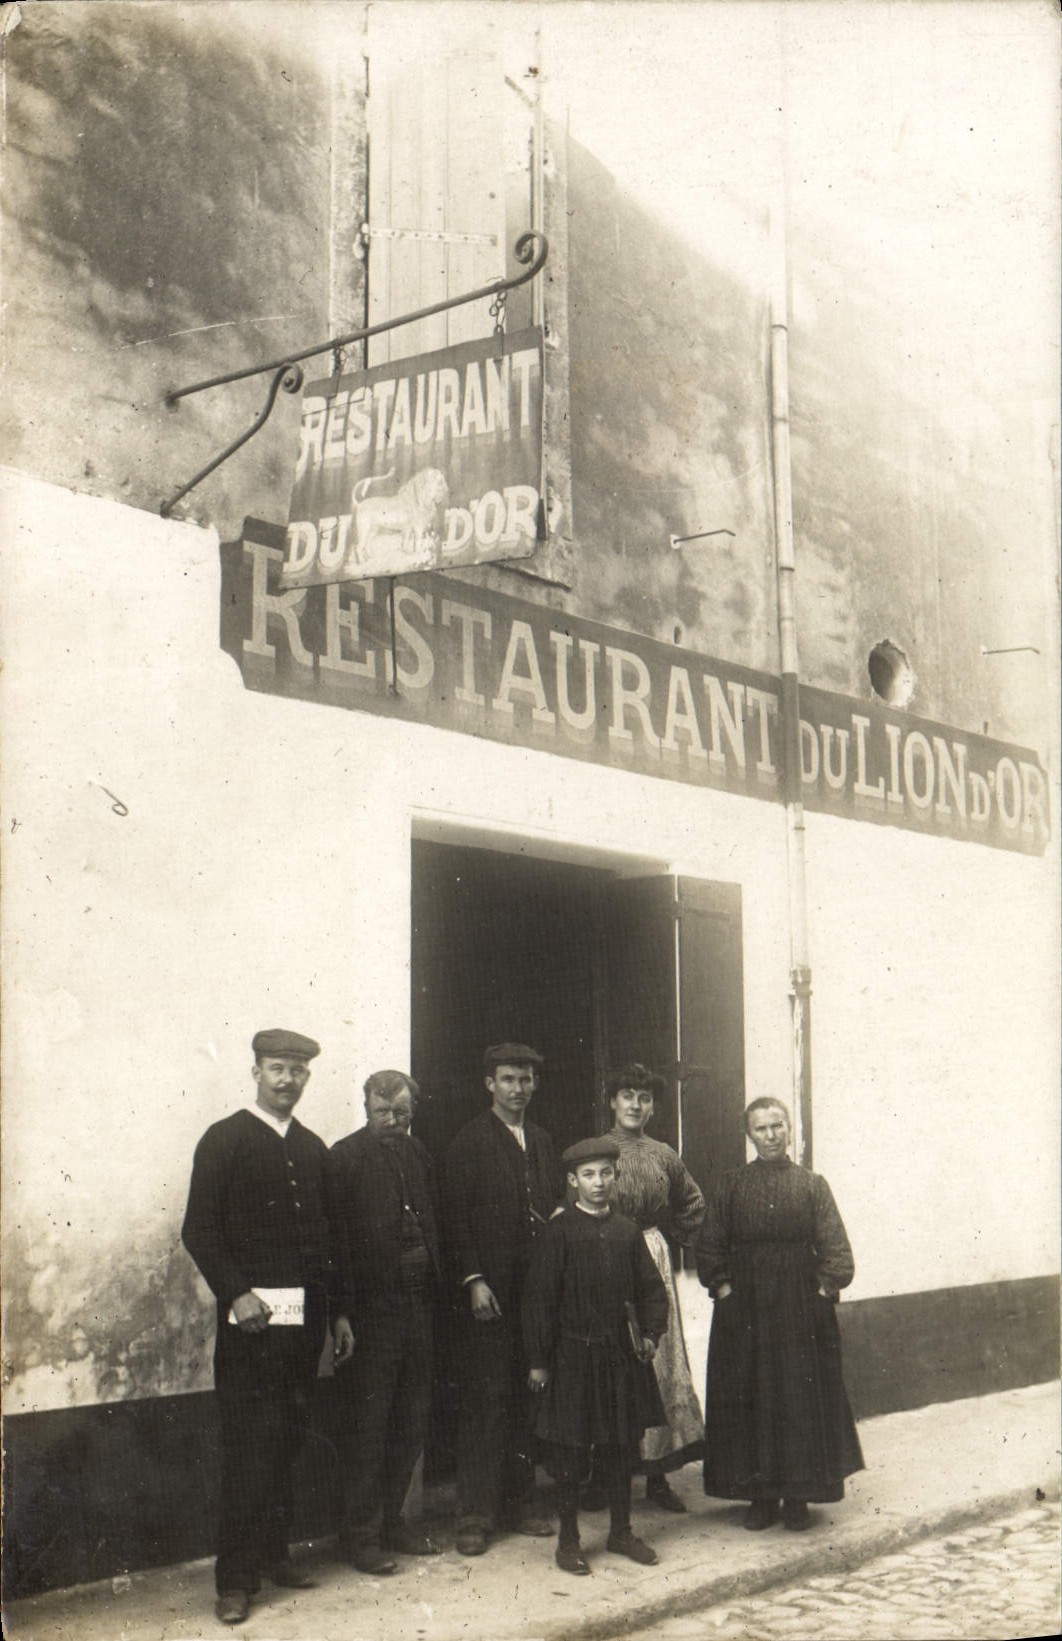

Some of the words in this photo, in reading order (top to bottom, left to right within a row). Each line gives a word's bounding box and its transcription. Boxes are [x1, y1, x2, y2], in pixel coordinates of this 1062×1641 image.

[295, 348, 540, 481] RESTAURANT
[283, 514, 352, 573] DU
[442, 485, 540, 550] D'OR
[243, 540, 779, 774] RESTAURANT
[799, 719, 849, 789] DU
[851, 714, 967, 818] LION
[968, 756, 1050, 837] D'OR
